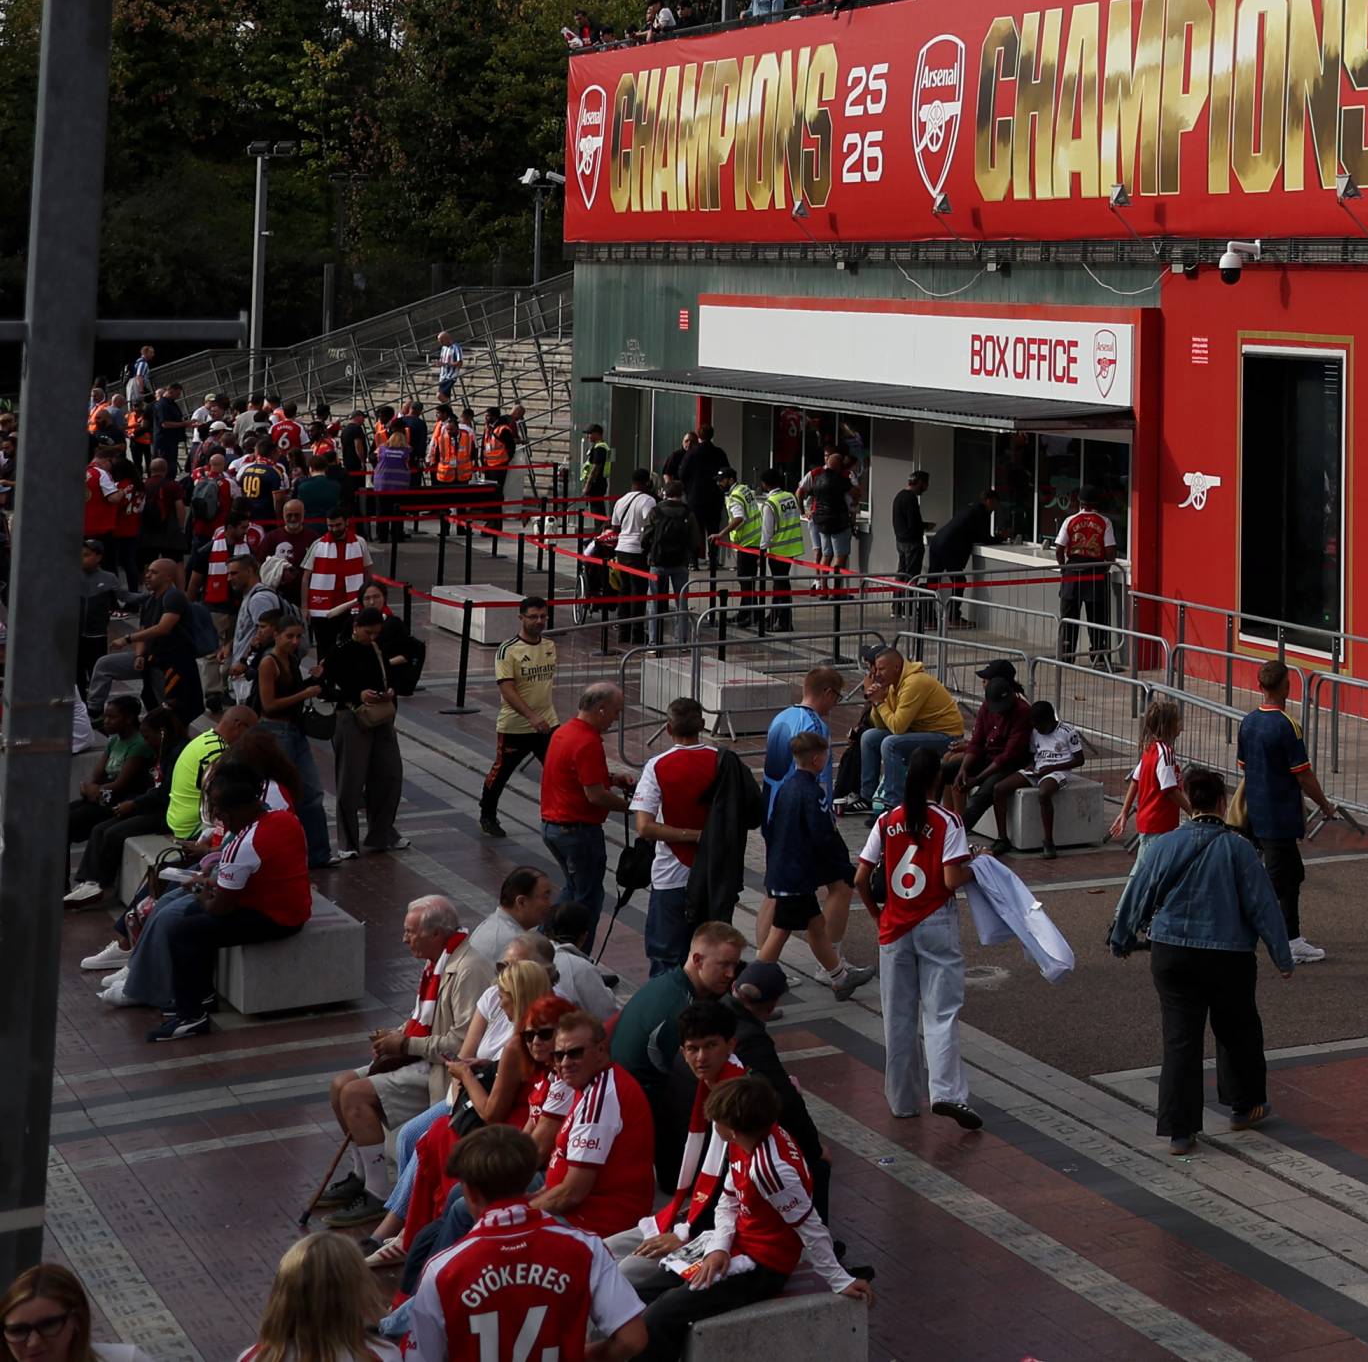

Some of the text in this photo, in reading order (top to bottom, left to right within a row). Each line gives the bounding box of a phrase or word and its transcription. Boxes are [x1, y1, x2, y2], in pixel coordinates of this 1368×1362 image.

[844, 62, 890, 118] 25
[920, 54, 958, 89] Arsenal
[582, 107, 602, 126] Arsenal
[608, 42, 838, 213] CHAMPIONS
[841, 130, 884, 184] 26
[970, 333, 1079, 384] BOX OFFICE
[1095, 341, 1114, 353] Arsenal
[278, 431, 290, 450] 6
[243, 475, 261, 498] 49
[890, 844, 927, 900] 6
[571, 1136, 602, 1151] deel.
[461, 1263, 571, 1309] GYÖKERES
